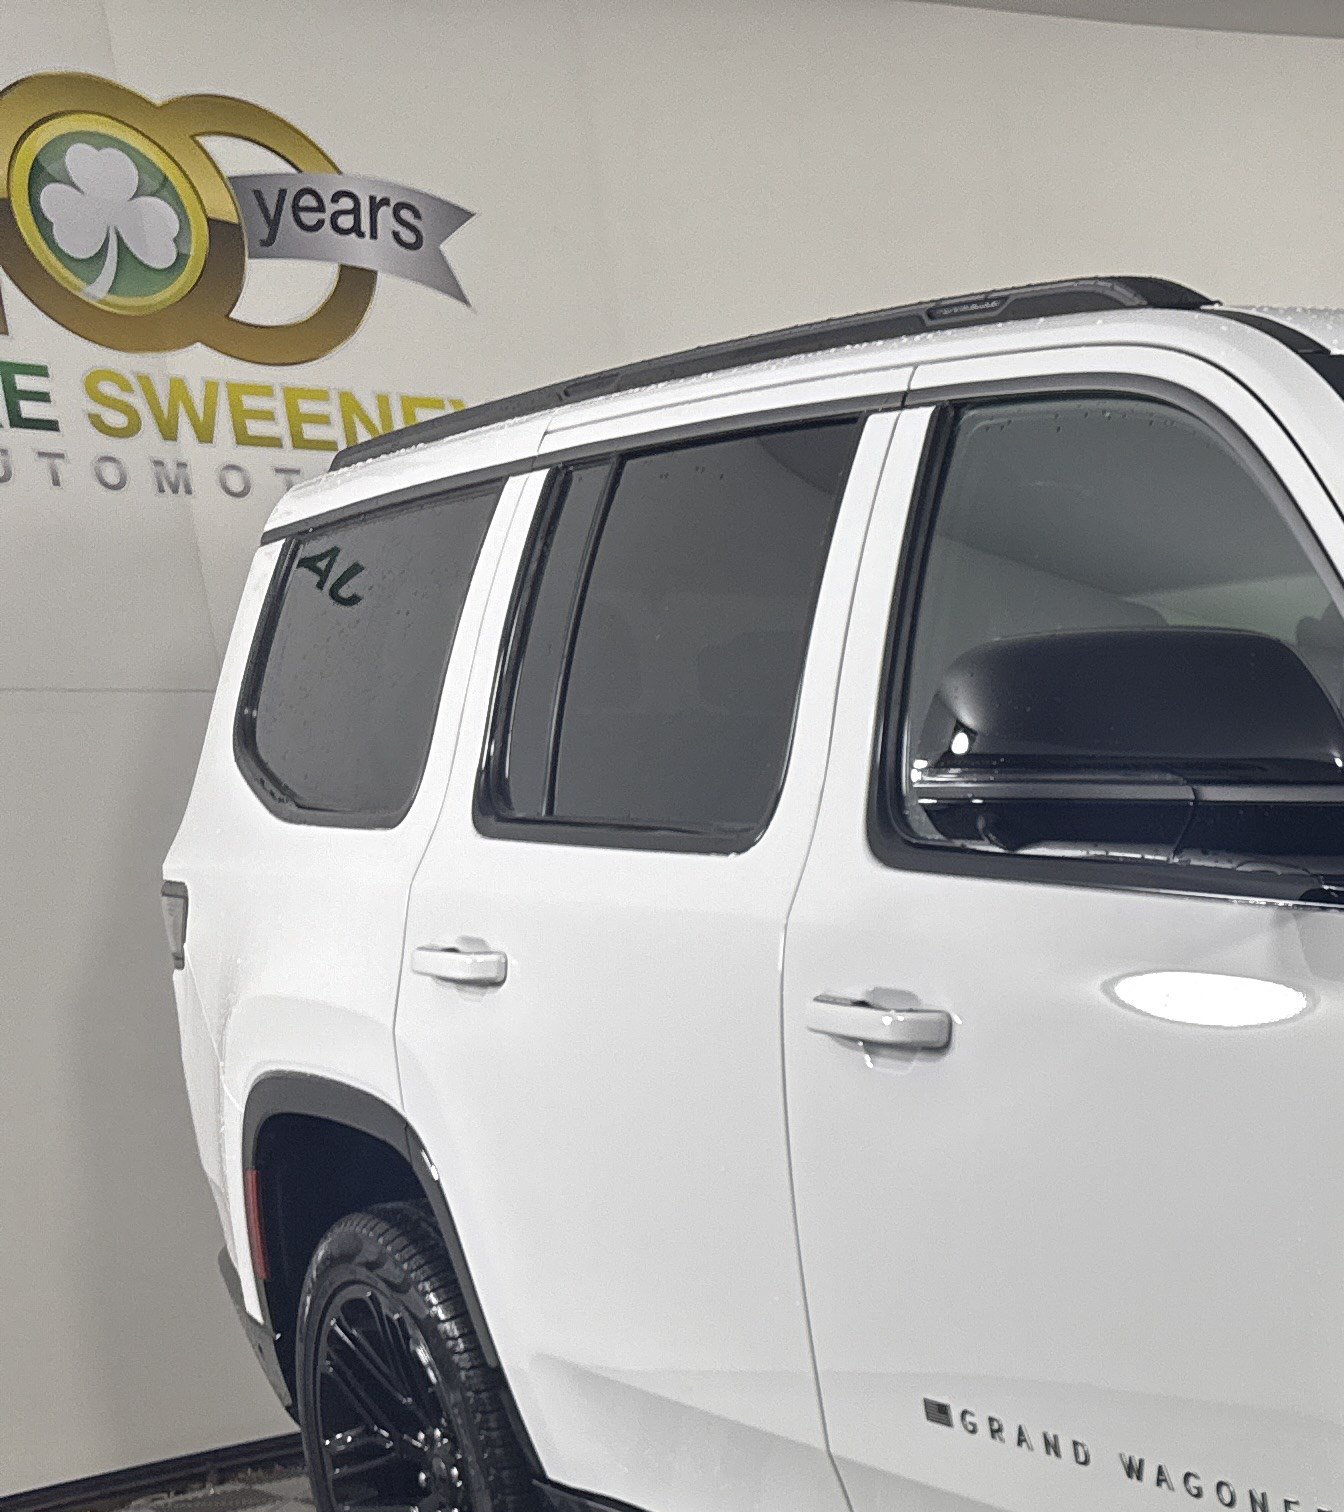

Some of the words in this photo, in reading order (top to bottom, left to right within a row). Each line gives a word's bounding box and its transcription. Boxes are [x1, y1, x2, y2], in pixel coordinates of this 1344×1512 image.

[253, 185, 425, 251] years
[83, 367, 467, 453] SWEEN
[959, 1408, 1091, 1467] GRAND
